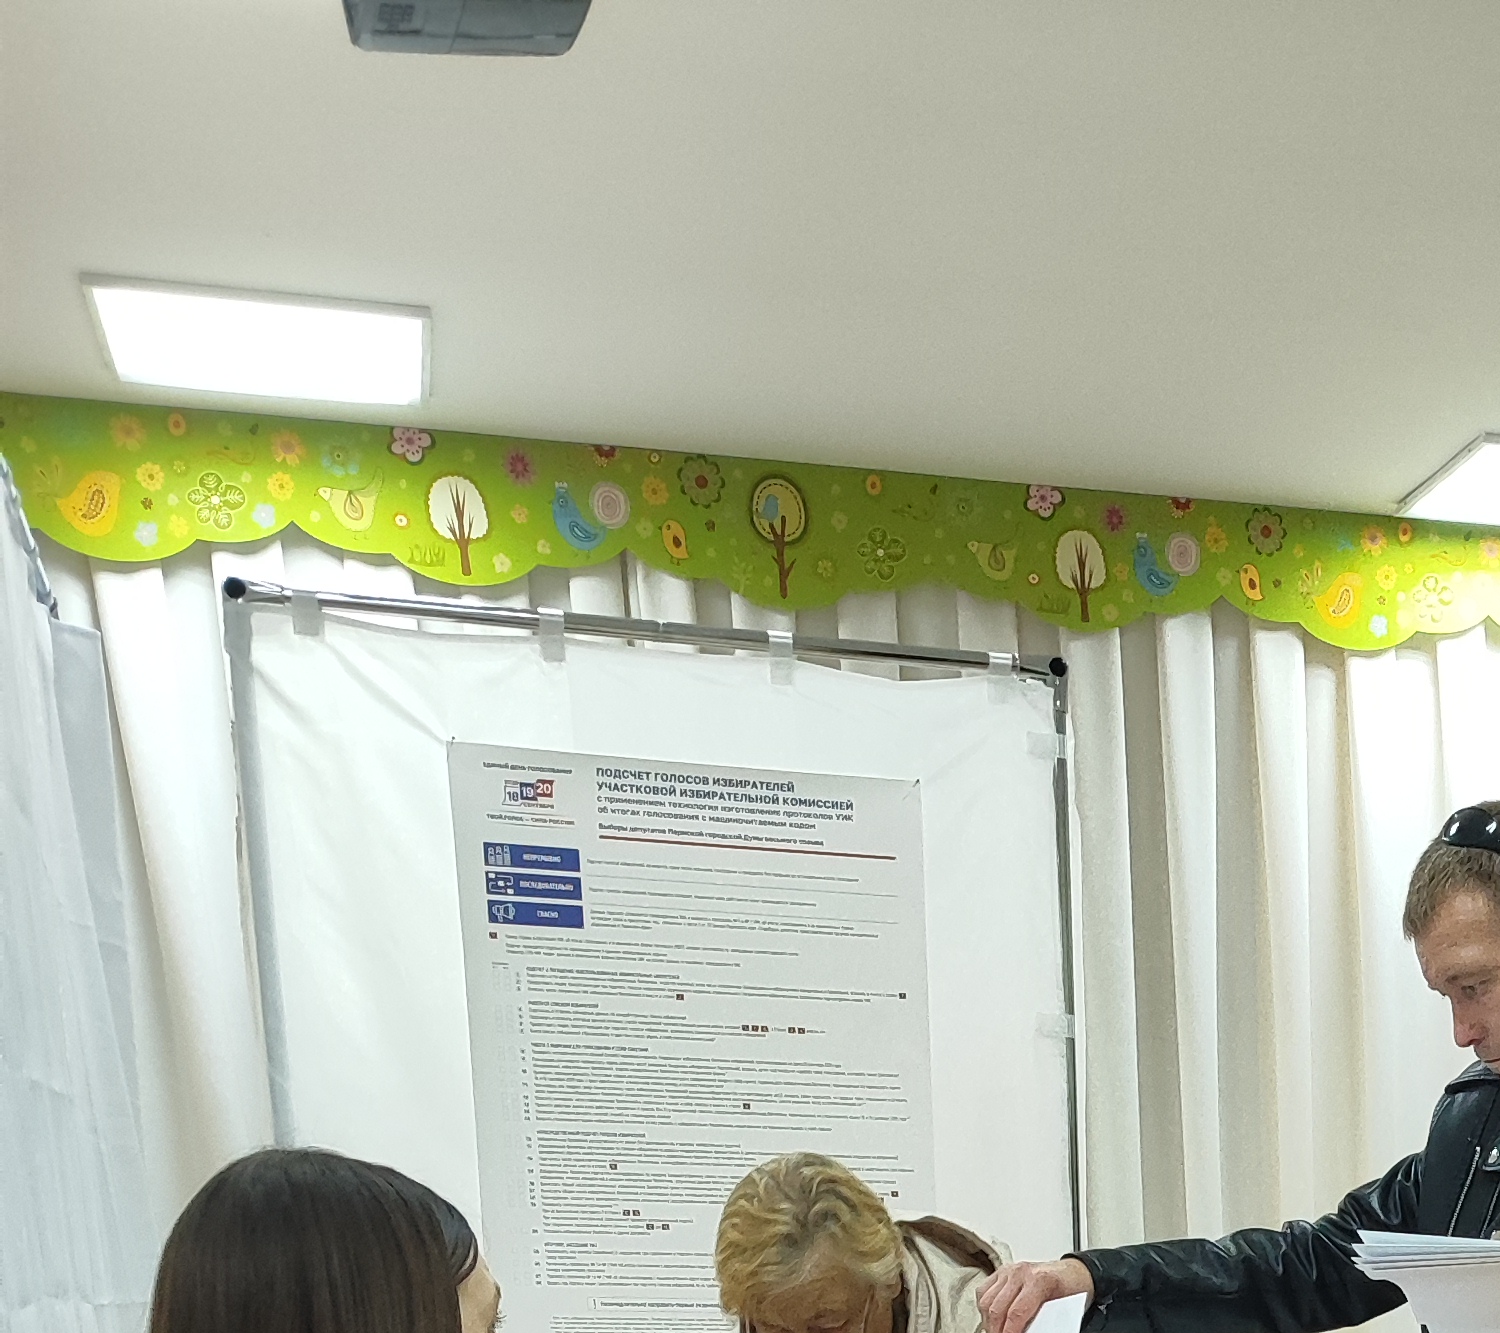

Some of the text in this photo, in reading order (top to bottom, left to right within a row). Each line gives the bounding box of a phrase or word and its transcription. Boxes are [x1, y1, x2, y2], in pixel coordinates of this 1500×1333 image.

[536, 783, 552, 794] 20
[596, 767, 795, 793] ПОДСЧЕТ ГОЛОСОВ ИЗБИРАТЕЛЕЙ
[521, 786, 534, 798] 19
[596, 781, 854, 811] УЧАСТКОВОЙ ИЗБИРАТЕЛЬНОЙ КОМИССИЕЙ
